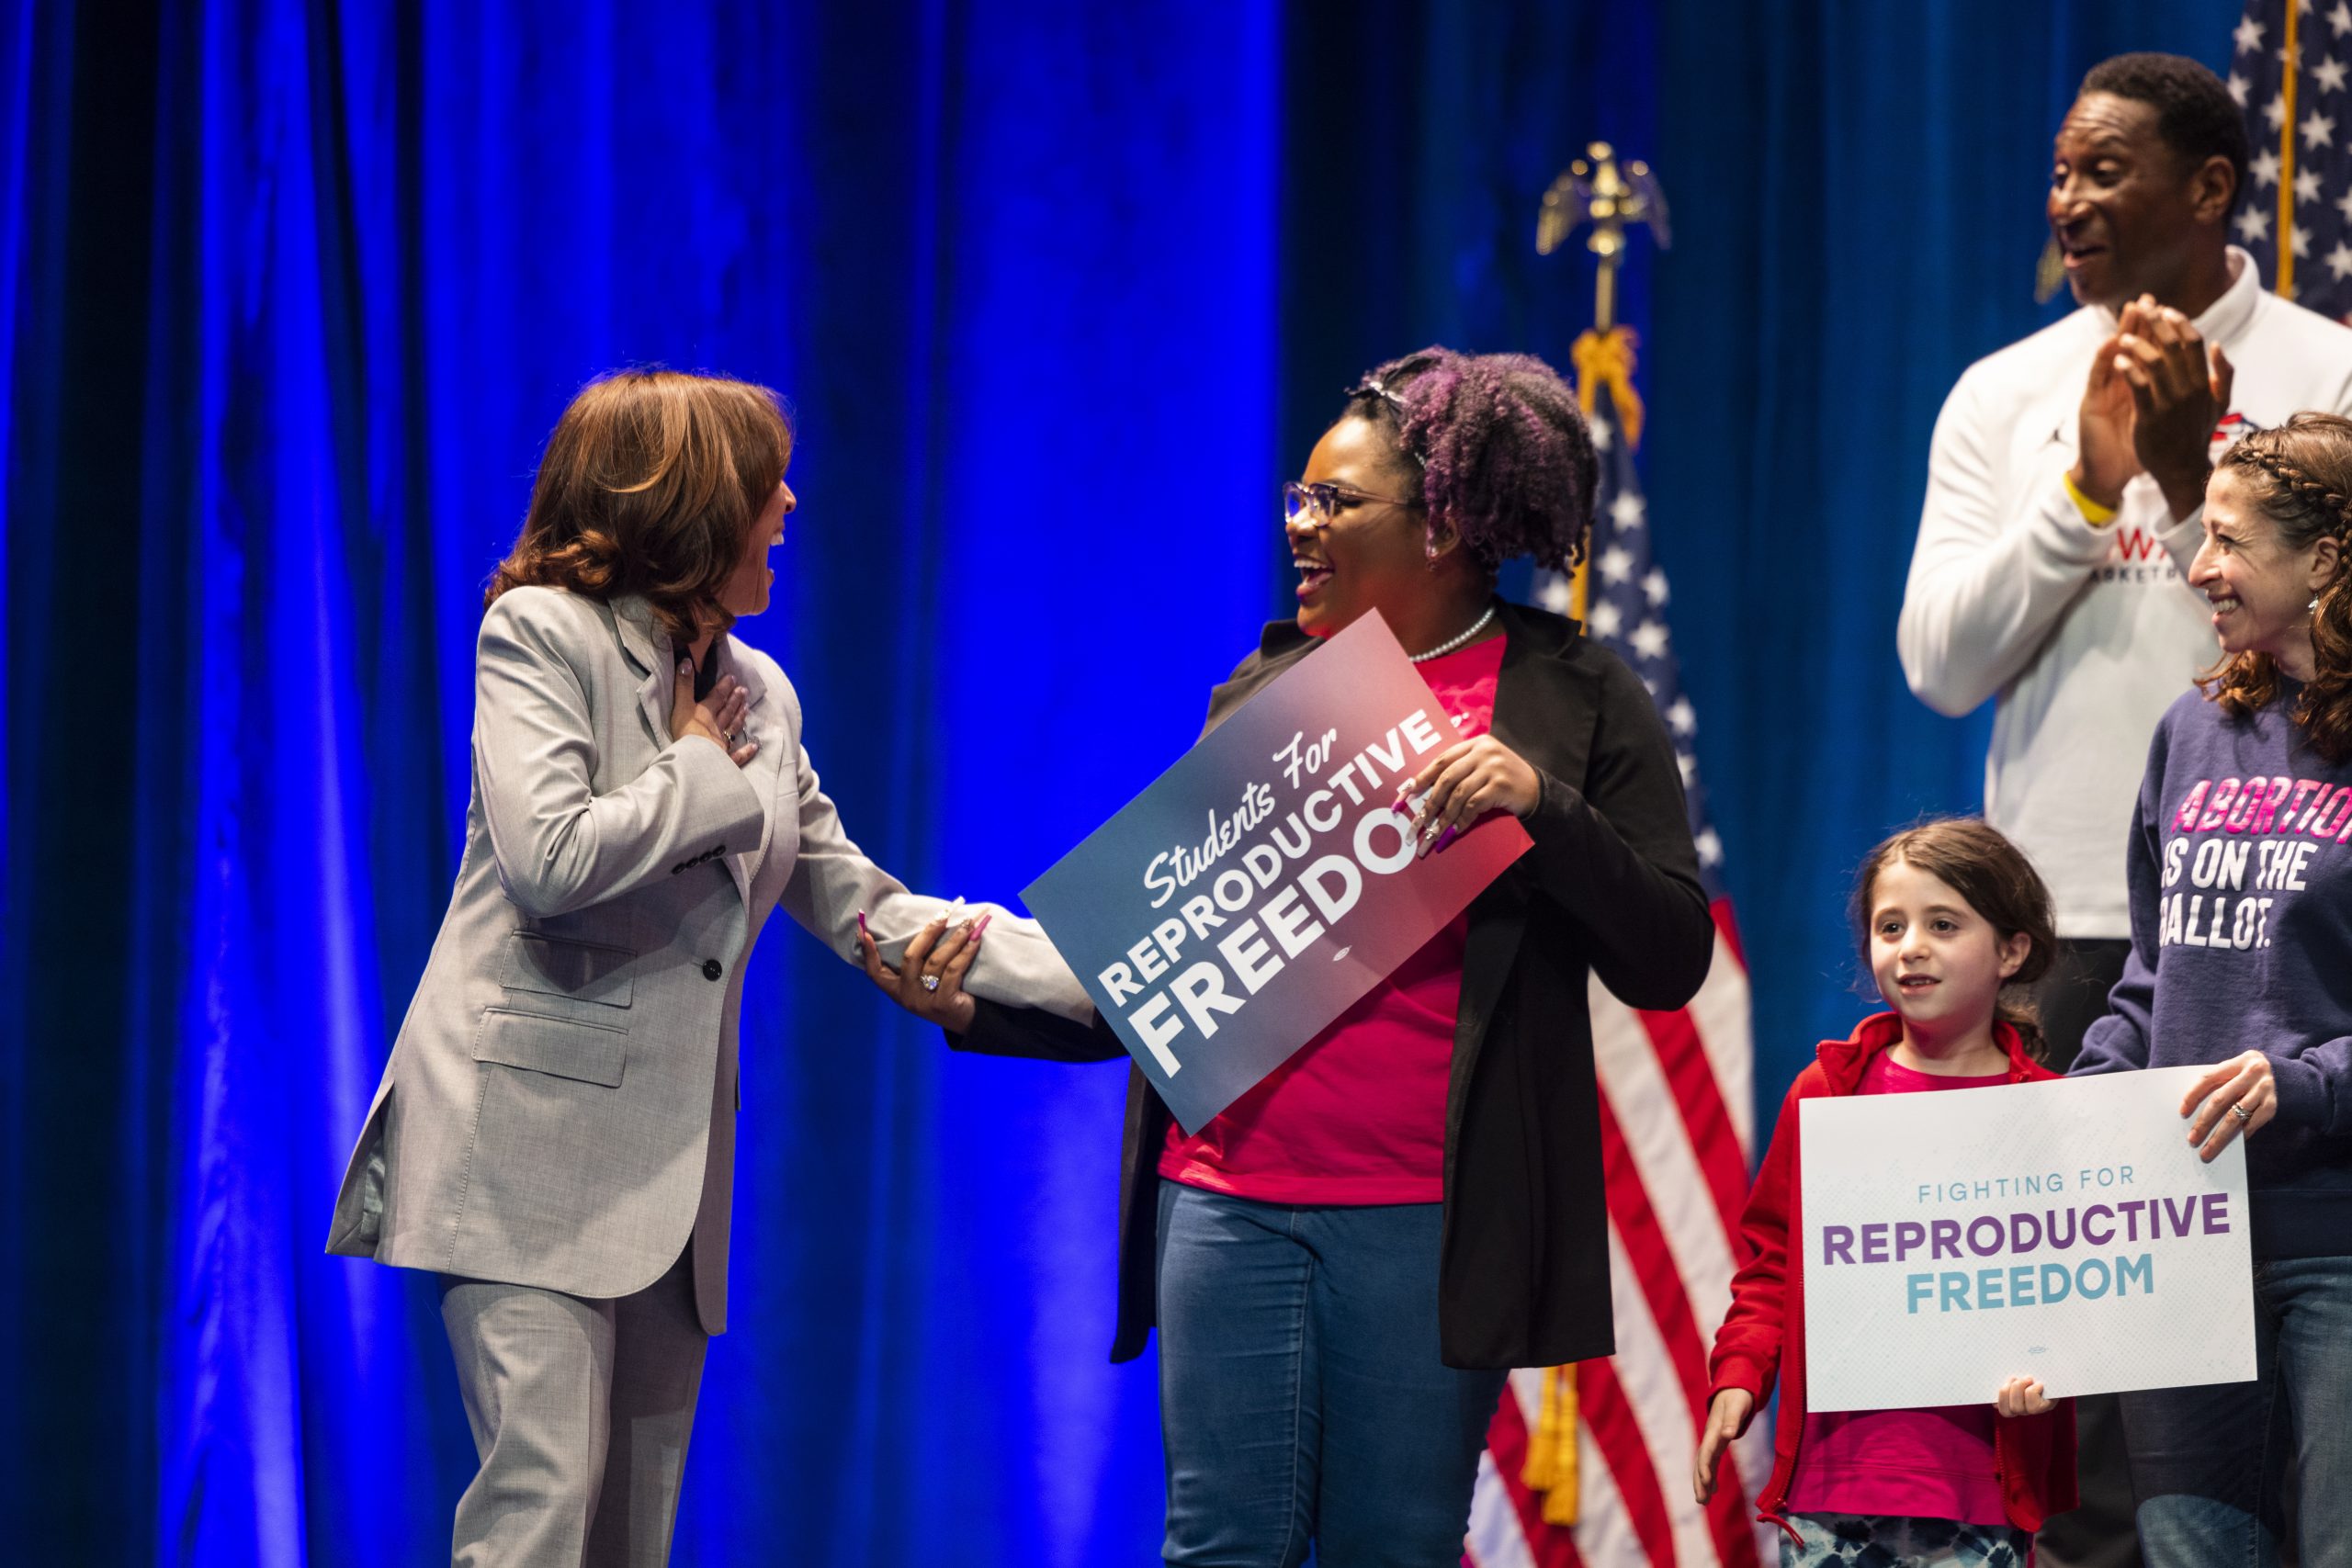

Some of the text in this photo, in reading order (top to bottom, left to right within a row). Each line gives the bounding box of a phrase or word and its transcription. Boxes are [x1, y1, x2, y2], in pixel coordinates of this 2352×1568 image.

[1144, 728, 1338, 908] Students For
[2170, 775, 2352, 844] ABORTIO
[1097, 707, 1442, 1008] REPRODUCTIVE
[2191, 838, 2253, 892] ON
[2256, 840, 2320, 892] THE
[1917, 1165, 2135, 1204] FIGHTING FOR
[1823, 1192, 2231, 1266] REPRODUCTIVE
[1906, 1253, 2154, 1314] FREEDOM
